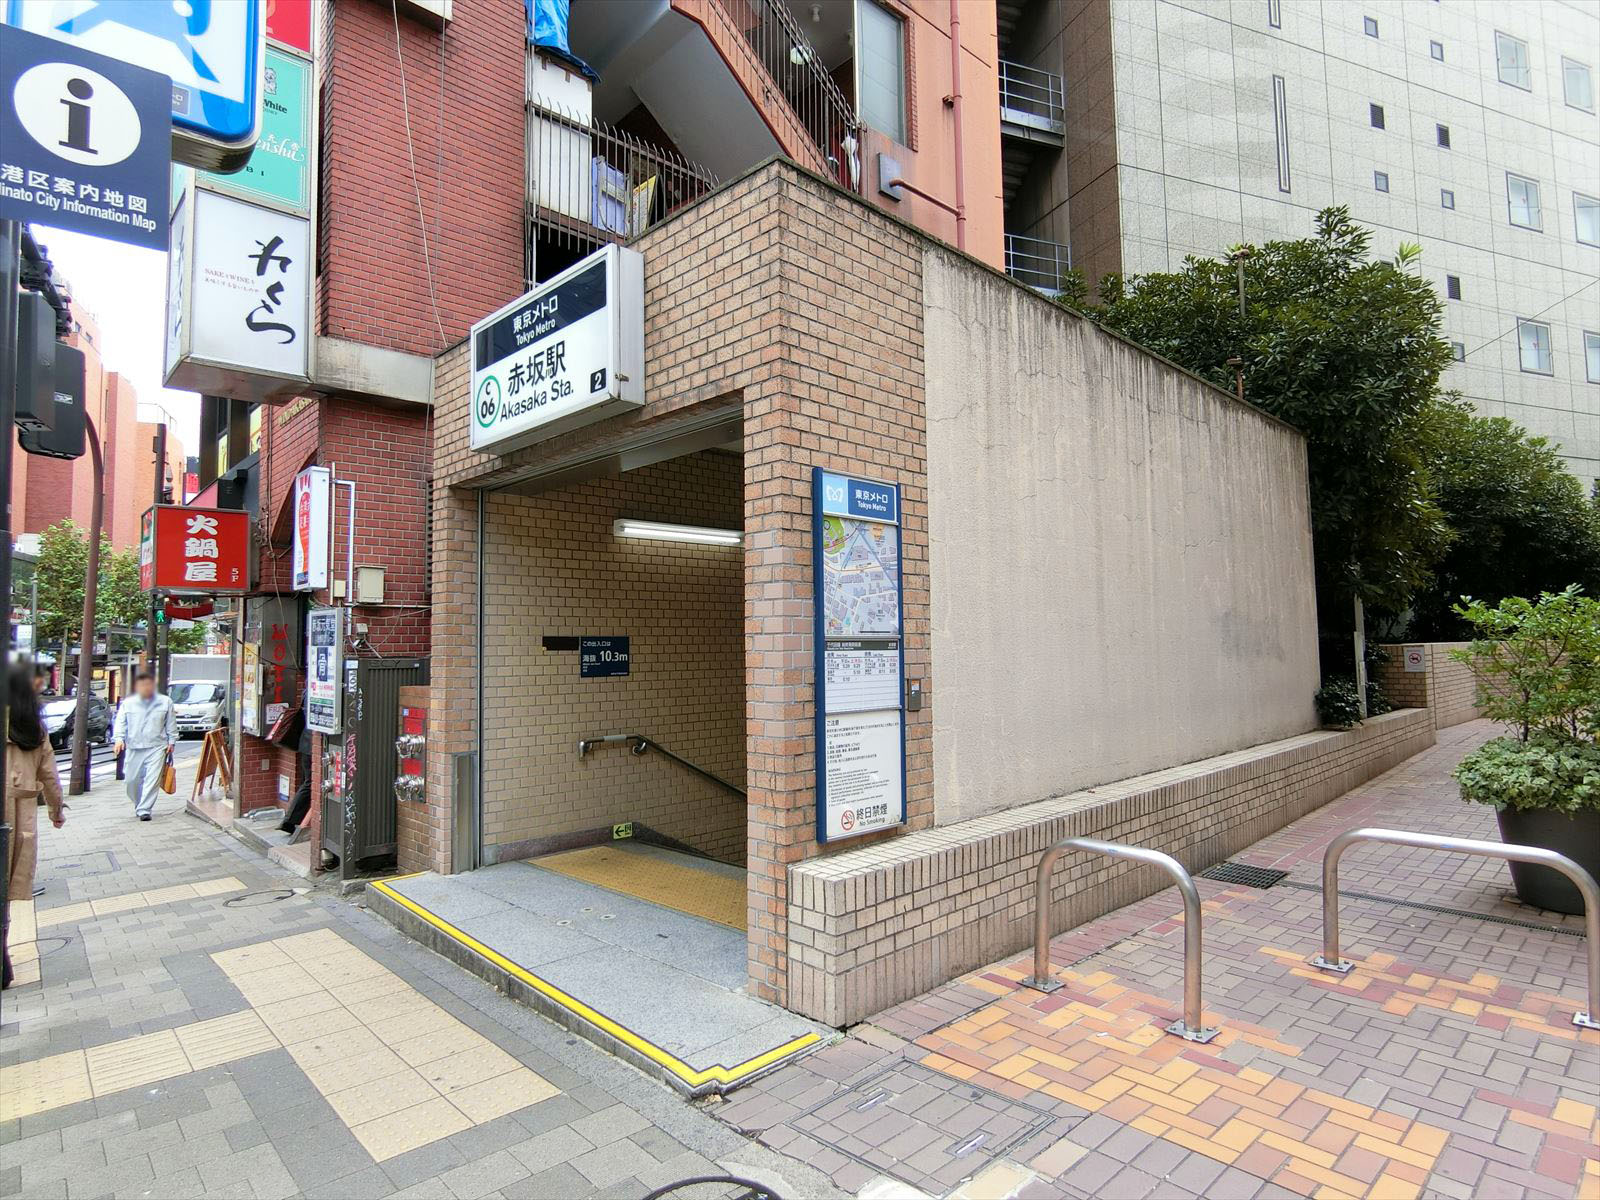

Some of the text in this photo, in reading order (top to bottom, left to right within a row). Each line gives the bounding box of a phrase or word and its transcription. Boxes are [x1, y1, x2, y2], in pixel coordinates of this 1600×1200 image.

[1, 163, 147, 213] 港区案内地図
[36, 191, 61, 211] City
[63, 197, 130, 224] Information
[132, 213, 157, 232] Map
[513, 295, 558, 334] 東京メトロ
[516, 320, 556, 346] Tokyo Metro
[507, 340, 567, 397] 赤坂駅
[485, 382, 491, 395] C
[594, 373, 602, 390] 2
[481, 398, 495, 419] 06
[500, 379, 574, 422] Akasaka Sta.
[855, 489, 888, 504] 東京メトロ
[857, 501, 886, 512] Tokyo Metro
[184, 514, 219, 582] 火鍋屋
[599, 650, 628, 662] 10.3m
[856, 803, 887, 820] 終日禁煙
